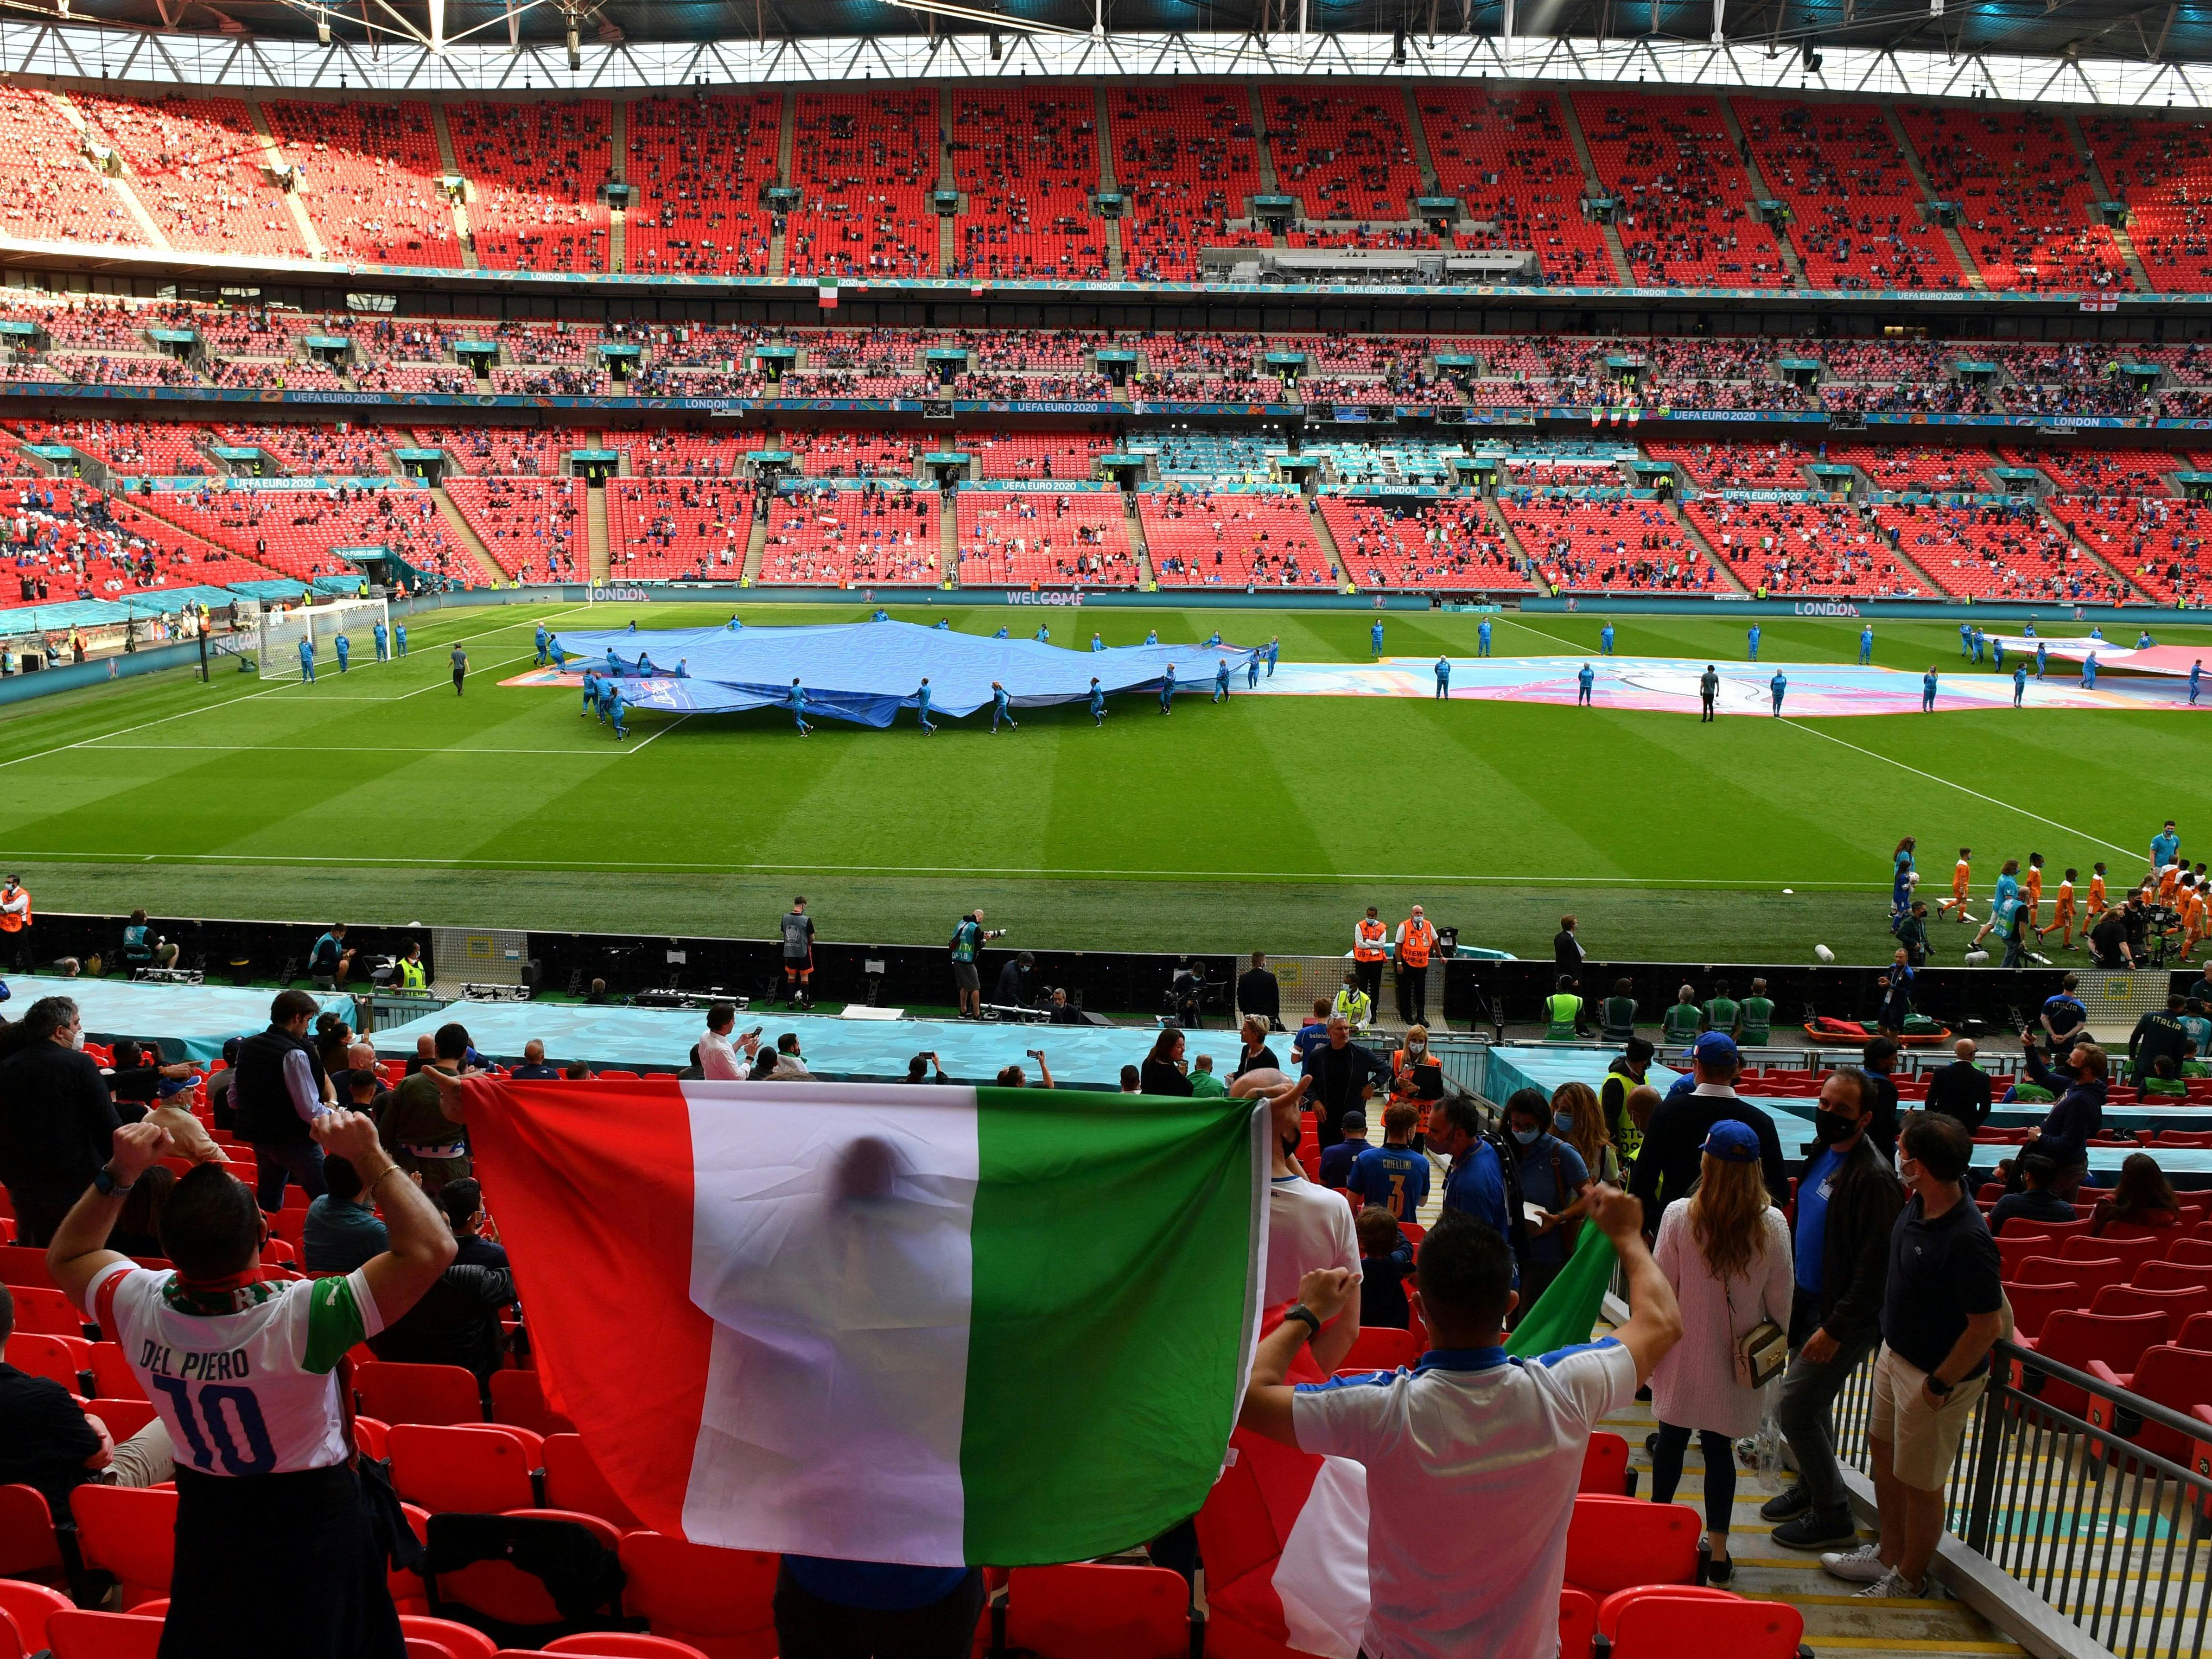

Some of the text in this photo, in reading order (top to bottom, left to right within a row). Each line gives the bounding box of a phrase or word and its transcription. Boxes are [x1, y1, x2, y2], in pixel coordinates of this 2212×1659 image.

[292, 393, 381, 403] UEFA EURO 2020
[685, 399, 729, 408] LONDON
[1018, 403, 1098, 412] UEFA EURO 2020
[1674, 411, 1756, 420] UEFA EURO 2020
[2054, 417, 2100, 426] LONDON
[235, 479, 316, 488] UEFA EURO 2020
[1002, 482, 1026, 490] UEFA
[1379, 486, 1418, 494] LONDON
[2053, 1002, 2078, 1011] ITALIA
[2152, 1016, 2181, 1031] ITALIA
[1383, 1159, 1411, 1170] CHIELLINI
[1387, 1174, 1406, 1219] 3
[140, 1338, 250, 1381] DEL PIERO
[153, 1373, 277, 1477] 10
[2199, 1459, 2208, 1473] 20
